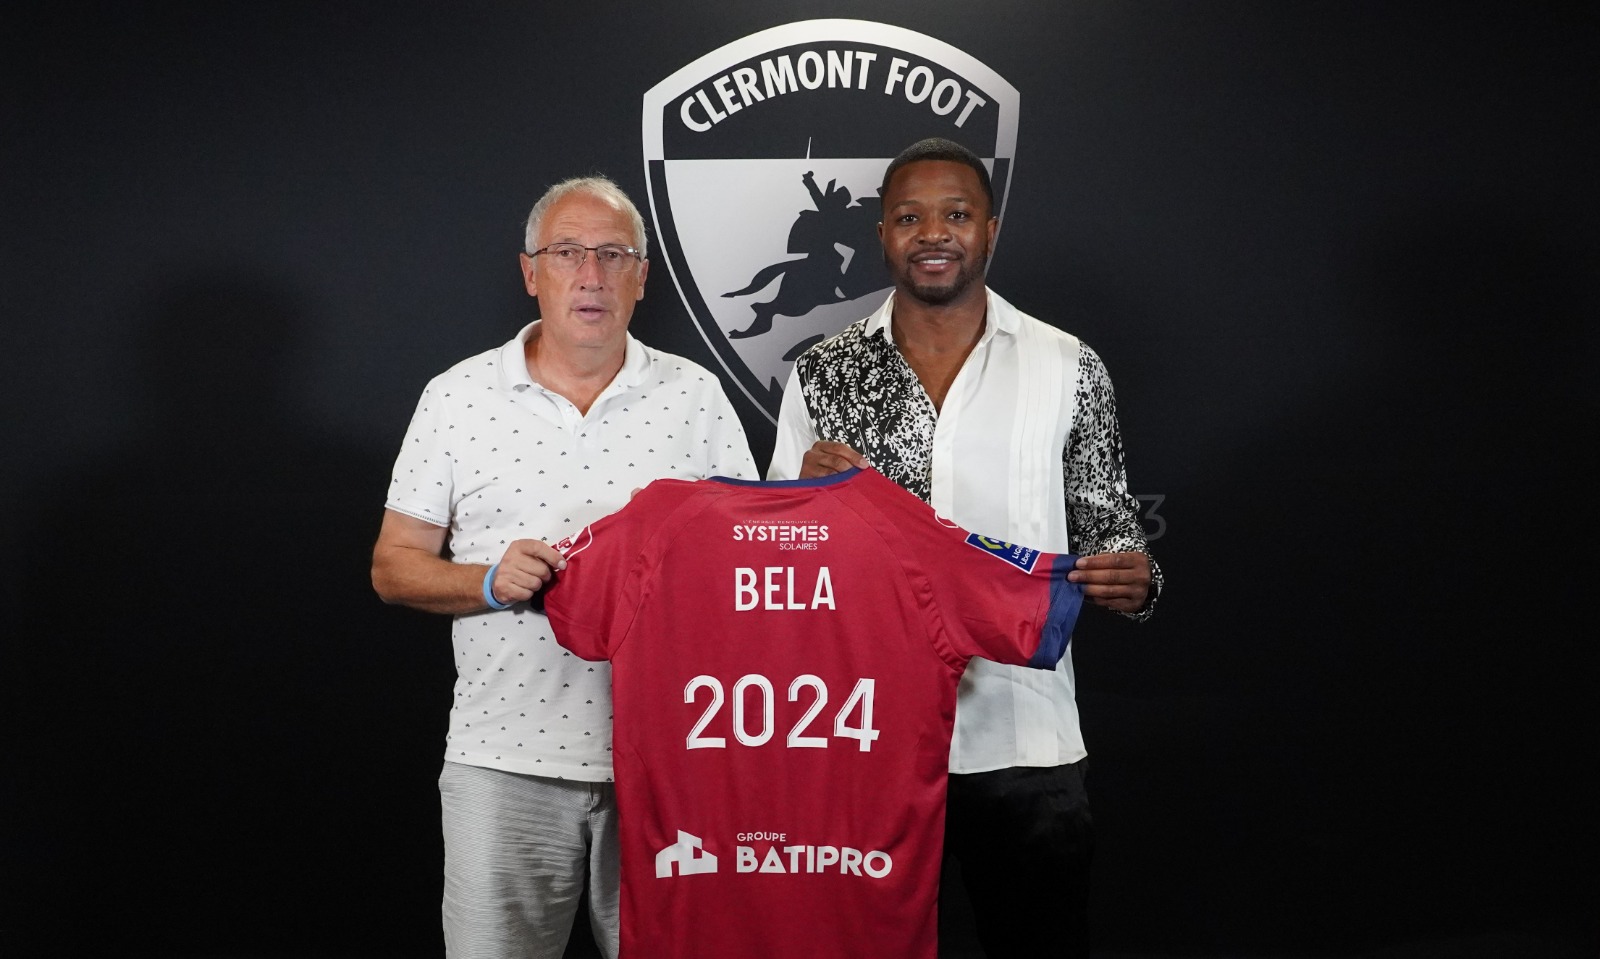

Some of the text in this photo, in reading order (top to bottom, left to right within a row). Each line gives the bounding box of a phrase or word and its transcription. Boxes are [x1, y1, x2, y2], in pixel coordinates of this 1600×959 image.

[680, 50, 986, 132] CLERMONT FOOT
[733, 525, 829, 541] SYSTEMES
[735, 567, 836, 611] BELA
[684, 674, 880, 752] 2024
[736, 831, 787, 842] GROUPE
[736, 845, 893, 879] BATIPRO
